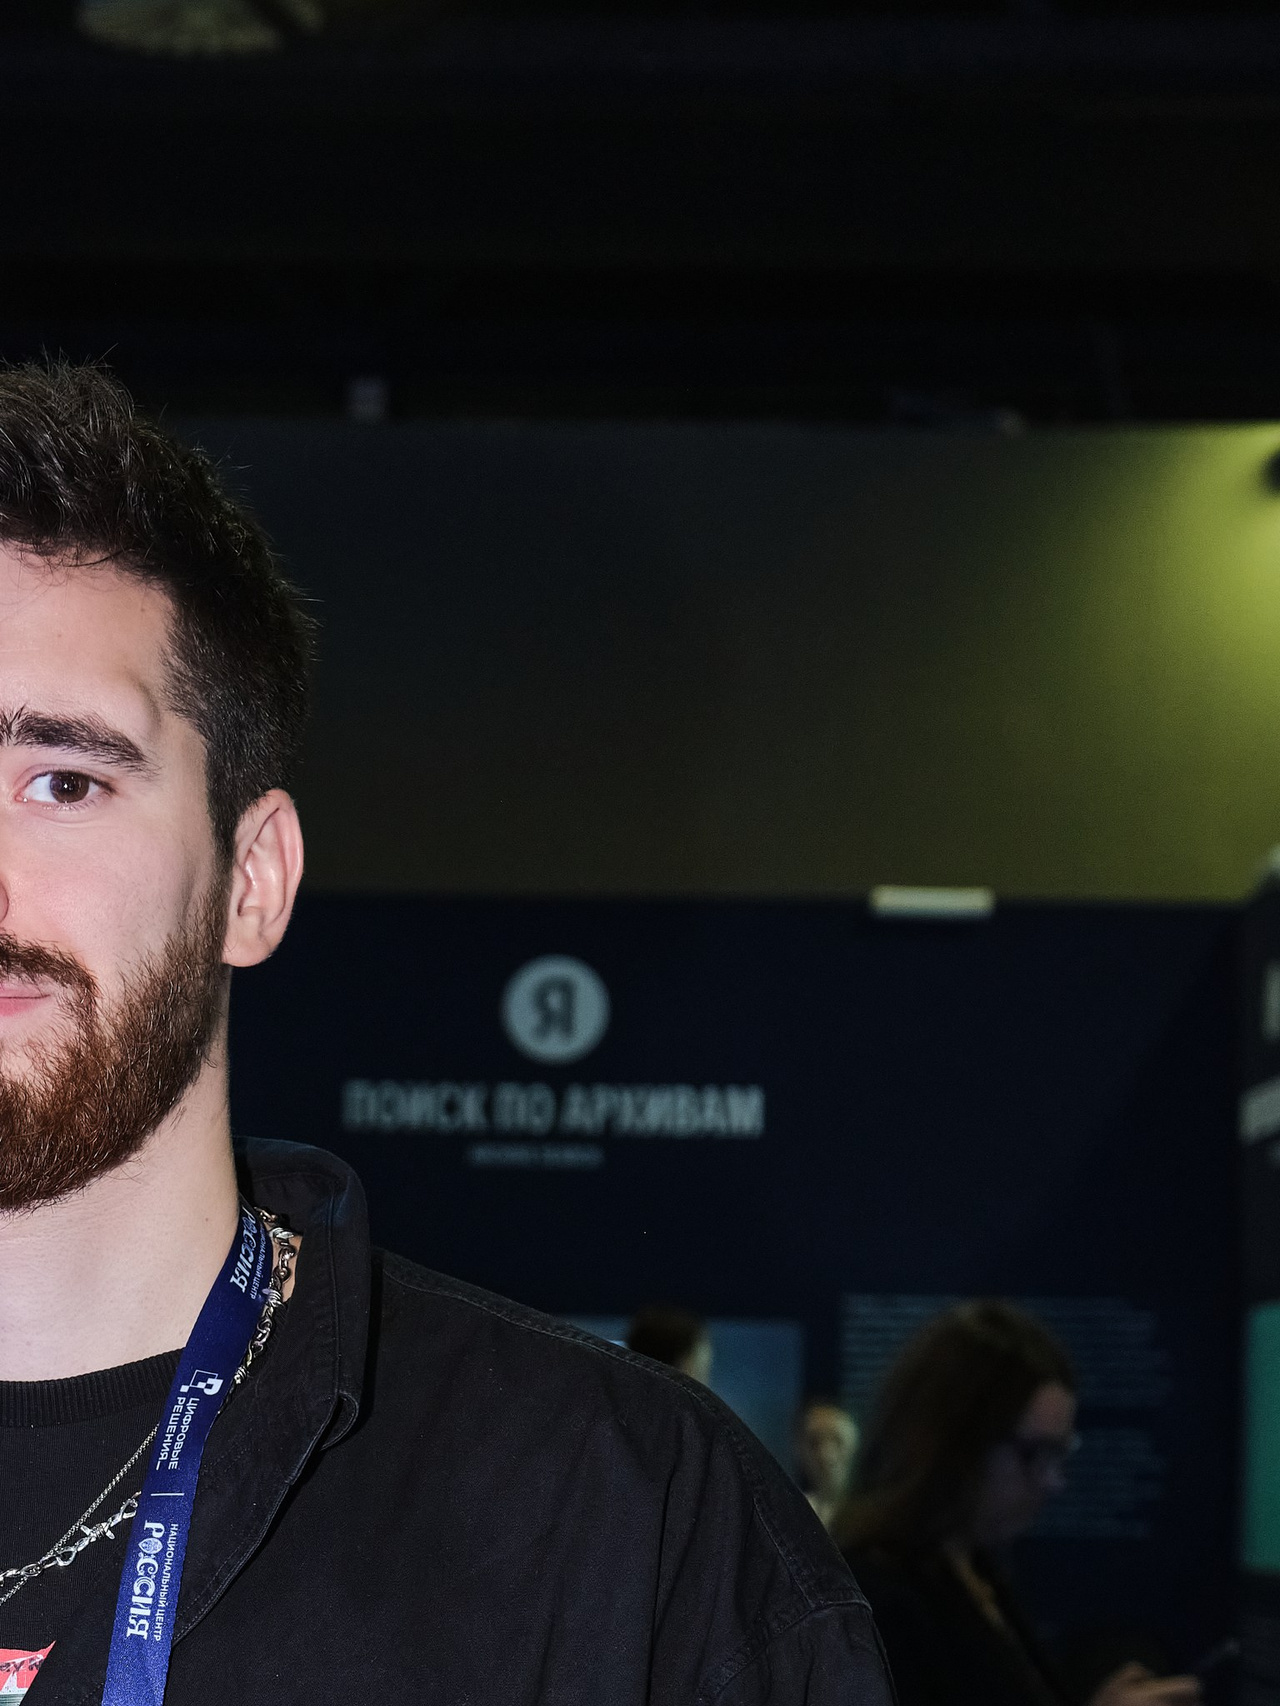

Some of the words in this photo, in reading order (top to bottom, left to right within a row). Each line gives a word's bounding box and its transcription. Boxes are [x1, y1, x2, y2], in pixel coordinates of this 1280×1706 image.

[532, 977, 576, 1041] Я
[341, 1079, 488, 1134] ПОИСК
[491, 1081, 556, 1136] ПО
[560, 1082, 766, 1138] АРХИВАМ
[168, 1397, 200, 1470] ЦИФРОВЫЕ
[126, 1519, 165, 1640] РОССИЯ
[157, 1523, 179, 1608] НАЦИОНАЛЬНЫЙ
[153, 1609, 166, 1641] ЦЕНТР
